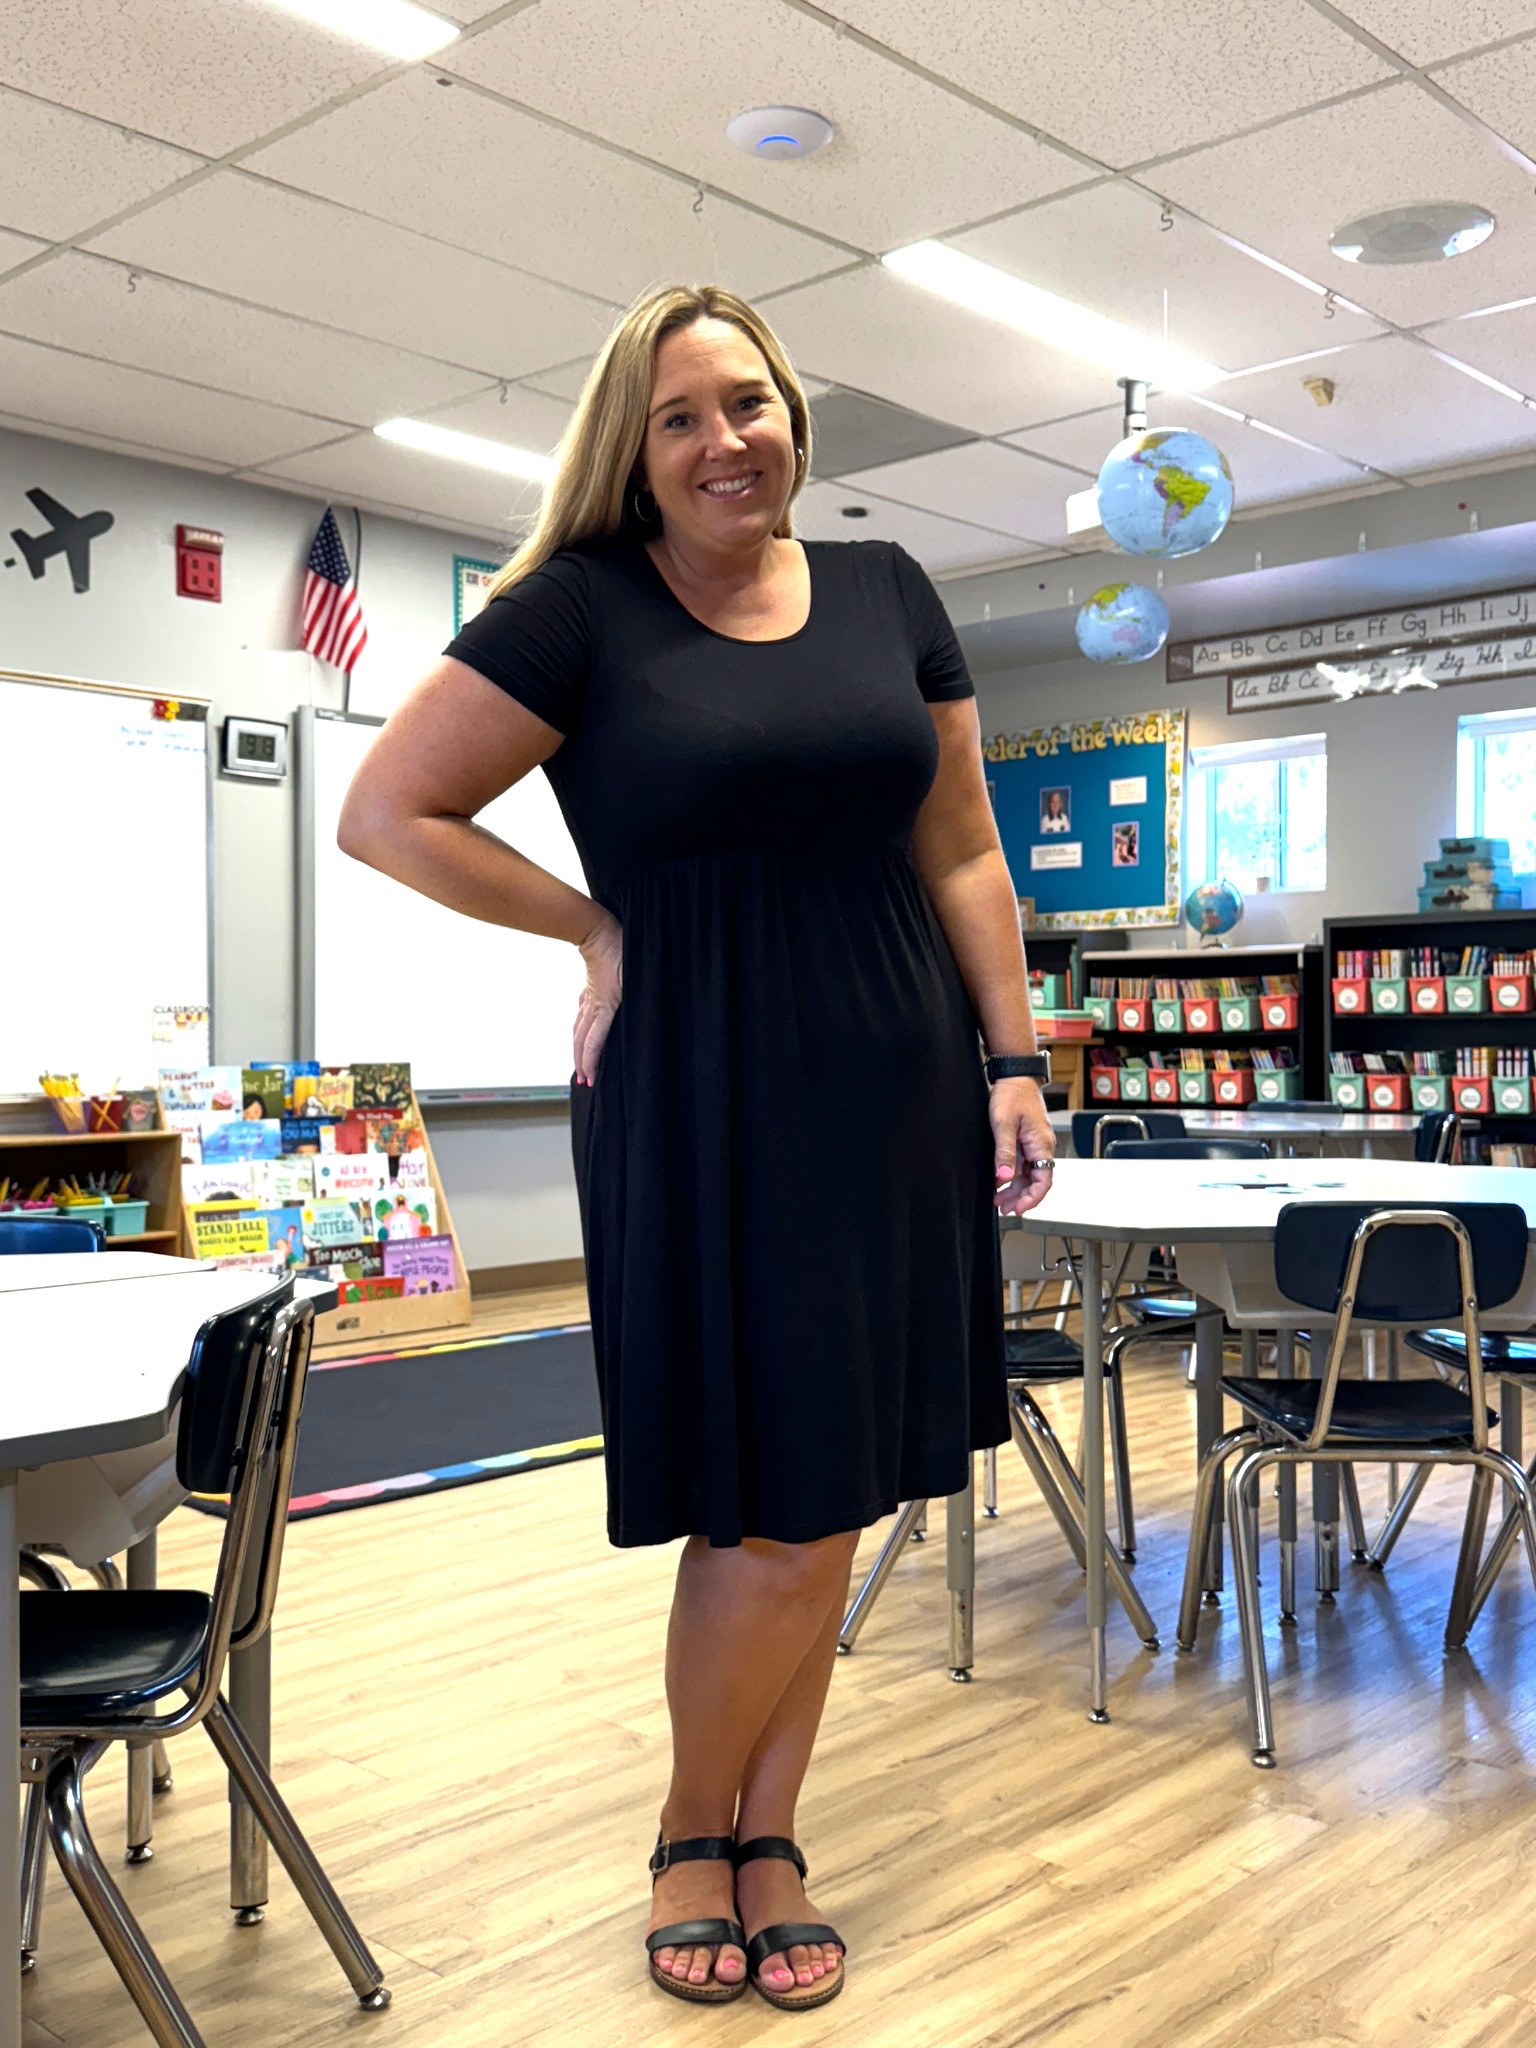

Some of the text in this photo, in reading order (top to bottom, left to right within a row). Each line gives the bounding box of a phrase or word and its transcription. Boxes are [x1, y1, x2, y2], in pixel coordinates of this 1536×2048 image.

[1196, 595, 1529, 664] Aa Bb Cc Dd Ee Ff Gg Hh Ii Jj
[1234, 680, 1259, 699] Aa
[1267, 674, 1291, 693] Bb
[1298, 671, 1319, 690] Cc
[1476, 645, 1505, 667] Hh
[1035, 731, 1060, 757] of
[1071, 725, 1107, 754] the
[1110, 715, 1175, 747] Week
[262, 1075, 285, 1094] Jar
[197, 1219, 265, 1237] STAND TALL
[311, 1219, 355, 1236] JITTERS
